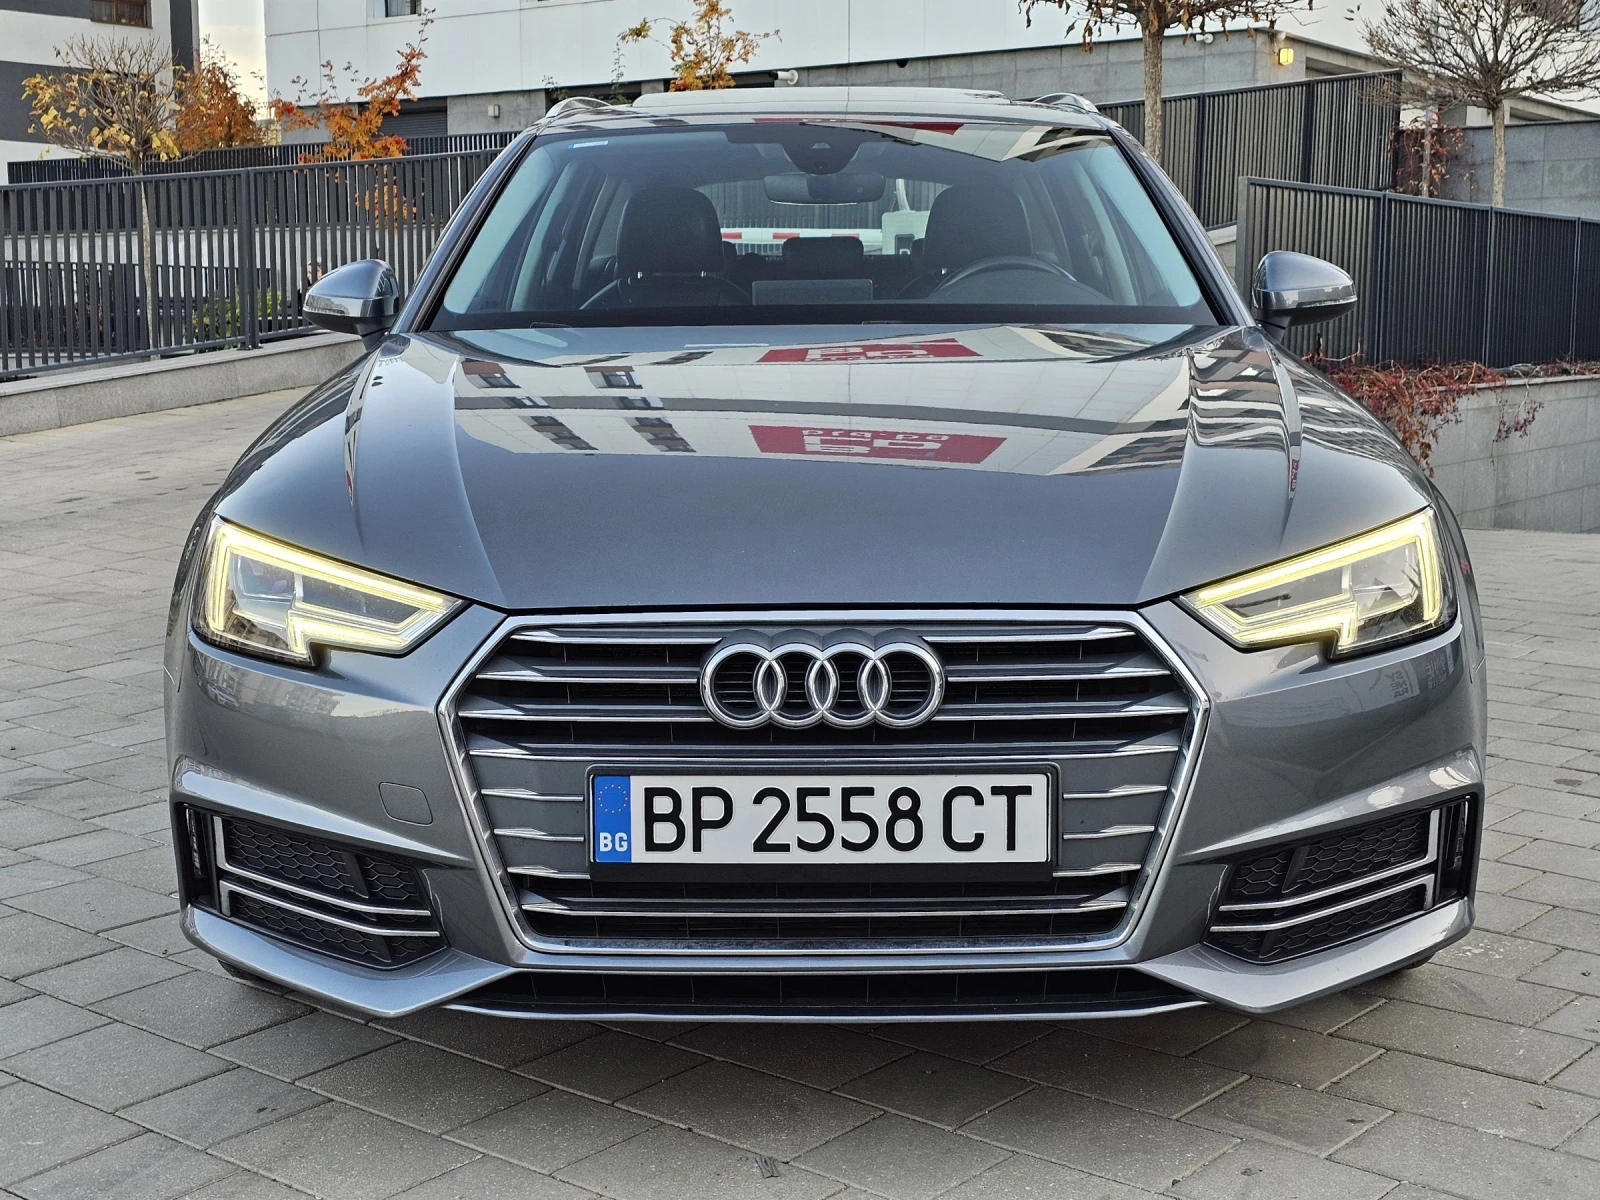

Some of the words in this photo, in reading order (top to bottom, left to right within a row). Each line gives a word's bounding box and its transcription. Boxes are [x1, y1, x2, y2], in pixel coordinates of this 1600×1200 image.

[644, 786, 734, 852] BP
[752, 786, 924, 853] 2558
[942, 785, 1033, 852] CT
[599, 832, 628, 852] BG
